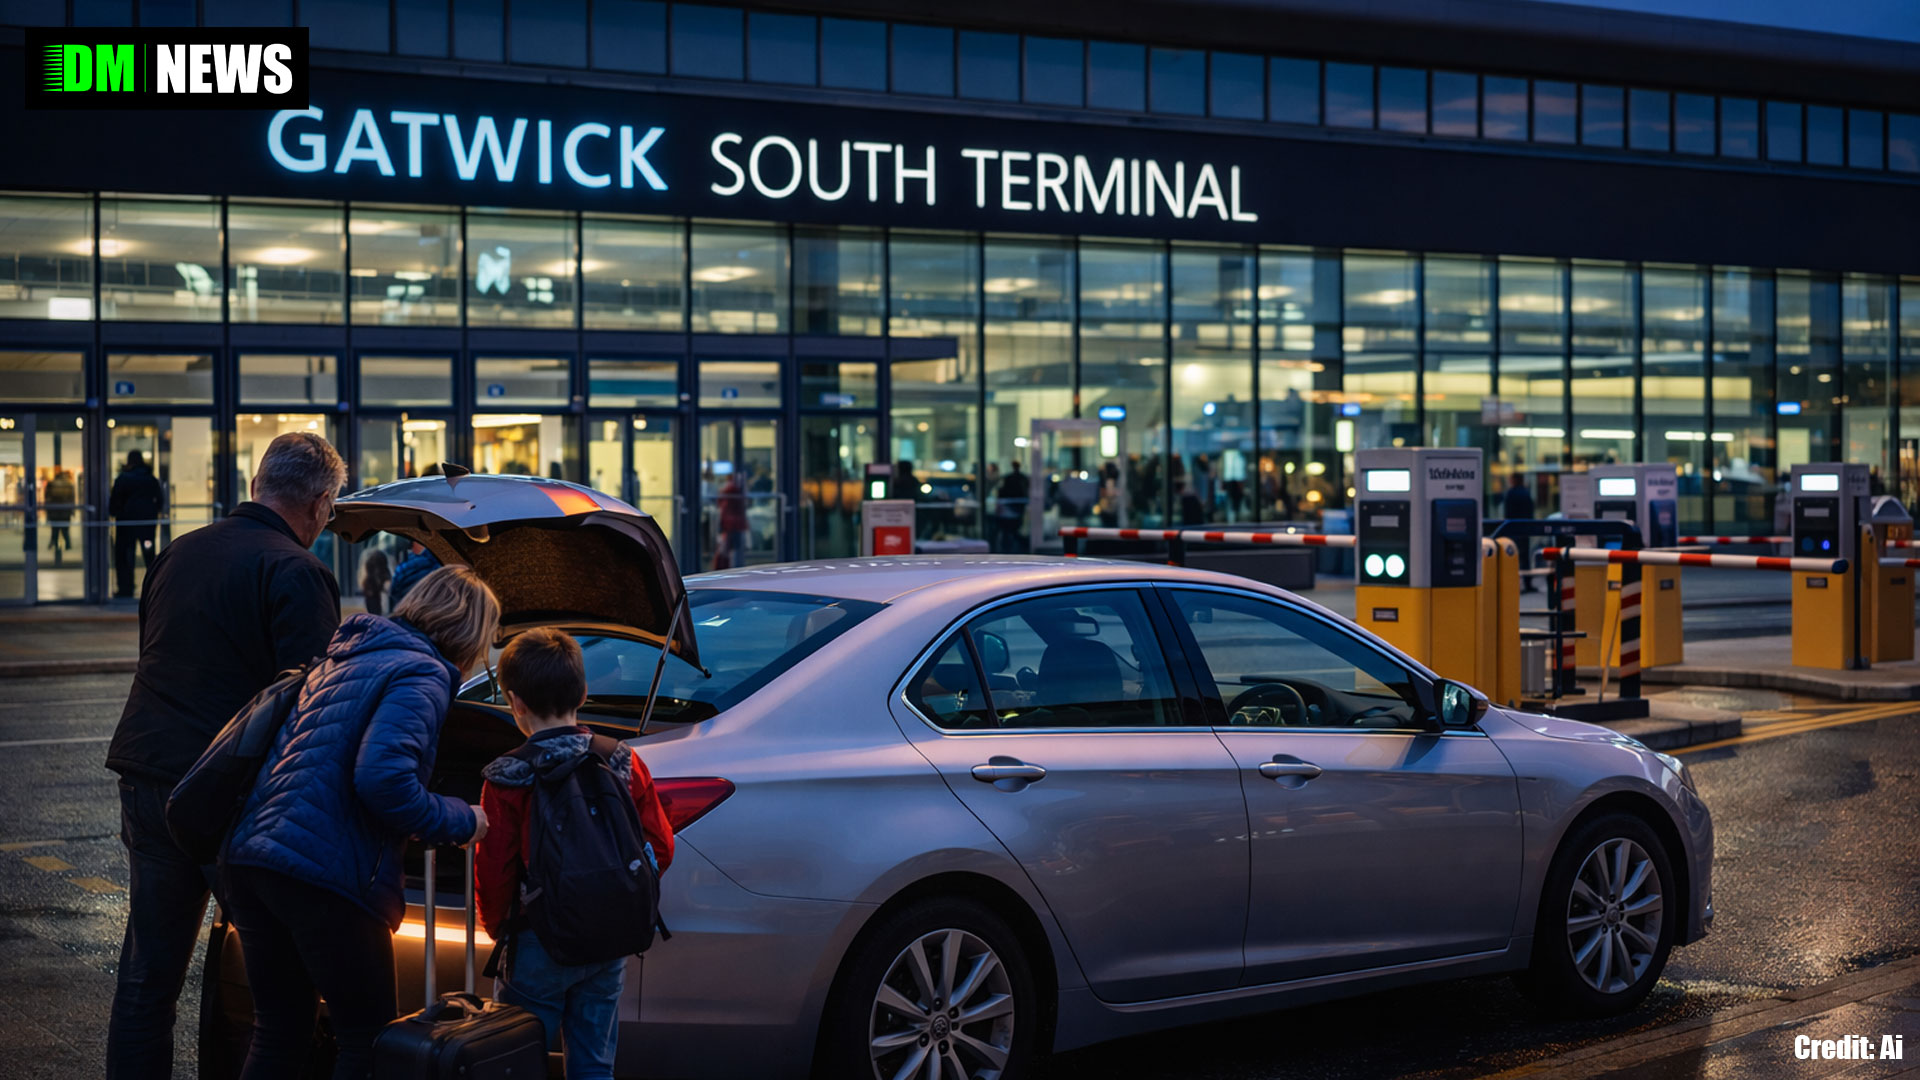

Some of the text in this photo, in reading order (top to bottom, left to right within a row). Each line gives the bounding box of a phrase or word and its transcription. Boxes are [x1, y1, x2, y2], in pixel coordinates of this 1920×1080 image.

[267, 105, 1258, 223] GATWICK SOUTH TERMINAL
